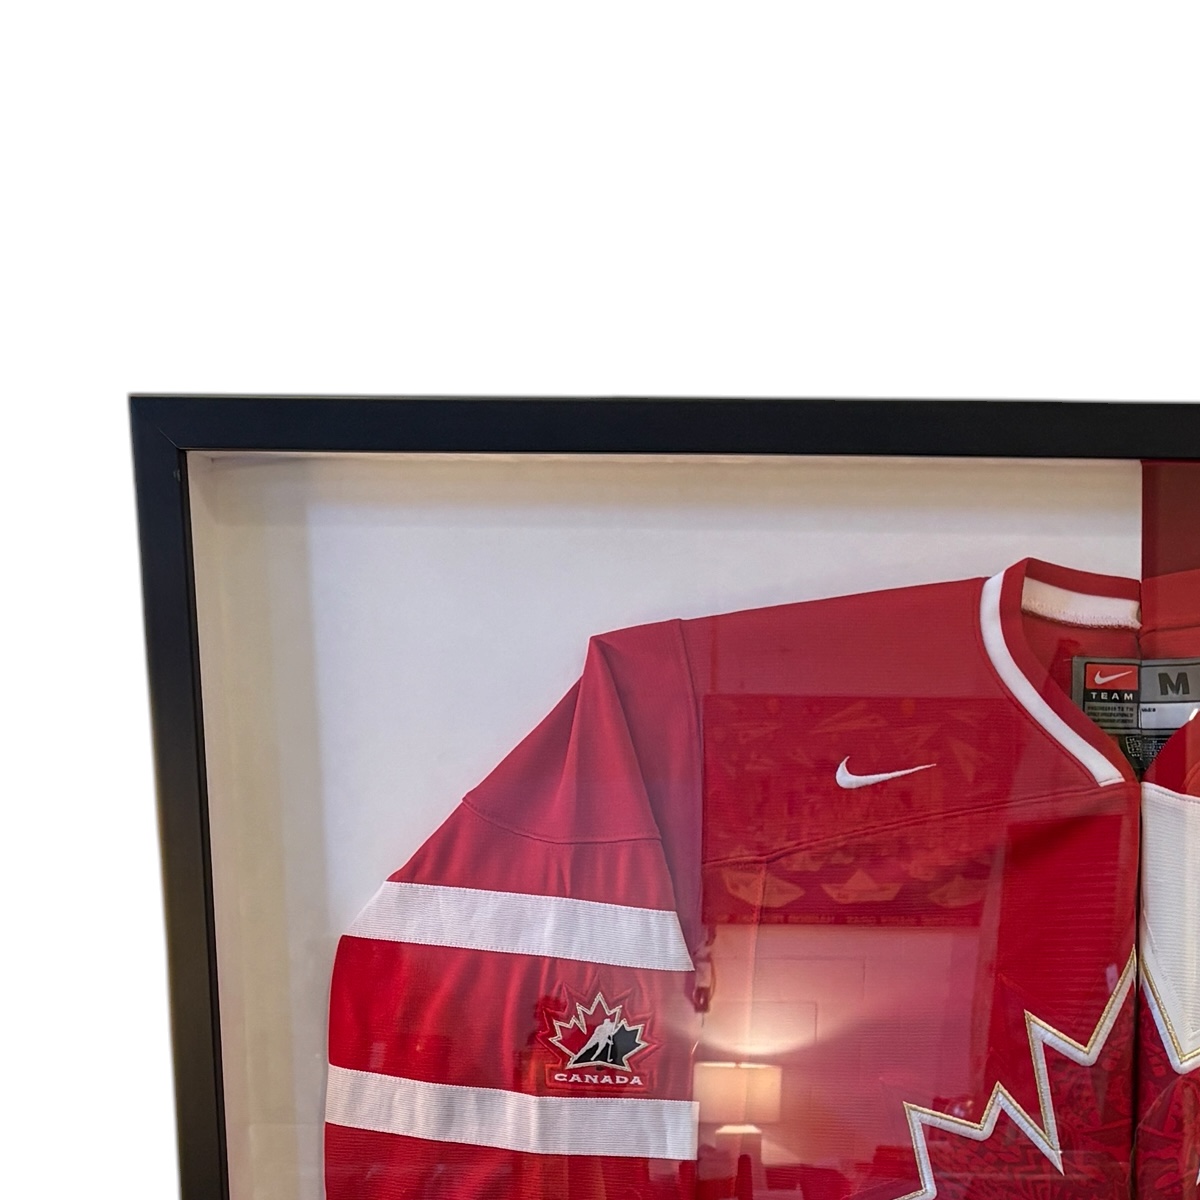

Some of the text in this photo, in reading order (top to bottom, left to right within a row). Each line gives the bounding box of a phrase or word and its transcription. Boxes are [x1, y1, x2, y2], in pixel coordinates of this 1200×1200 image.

[1158, 672, 1190, 696] M
[1090, 691, 1134, 700] TEAM
[553, 1073, 644, 1086] CANADA
